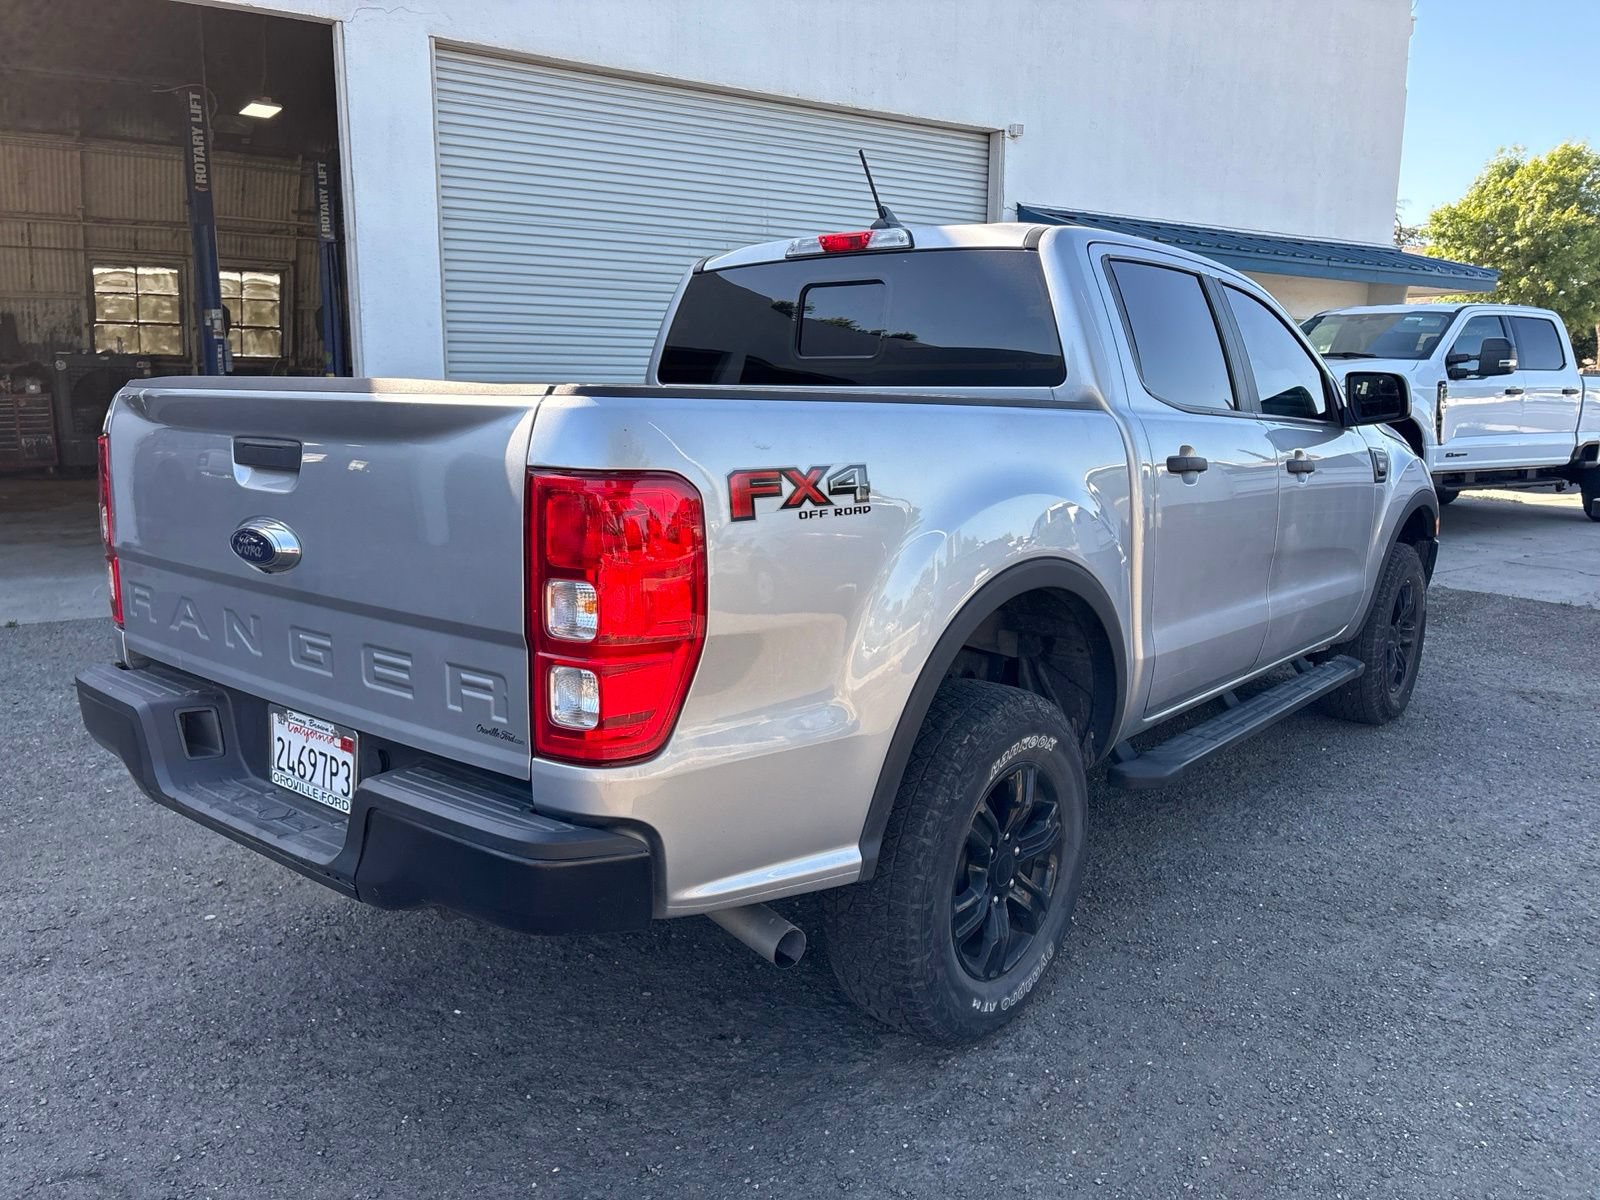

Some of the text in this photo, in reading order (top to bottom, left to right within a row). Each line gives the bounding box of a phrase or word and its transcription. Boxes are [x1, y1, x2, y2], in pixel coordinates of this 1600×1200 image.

[189, 92, 208, 184] ROTARY LIFT
[317, 162, 331, 232] ROTARY LIFT
[726, 464, 871, 522] FX4
[799, 505, 872, 520] OFF ROAD
[126, 580, 509, 724] RANGER
[272, 771, 350, 812] OROVILLE FORD
[276, 736, 351, 798] 24697P3
